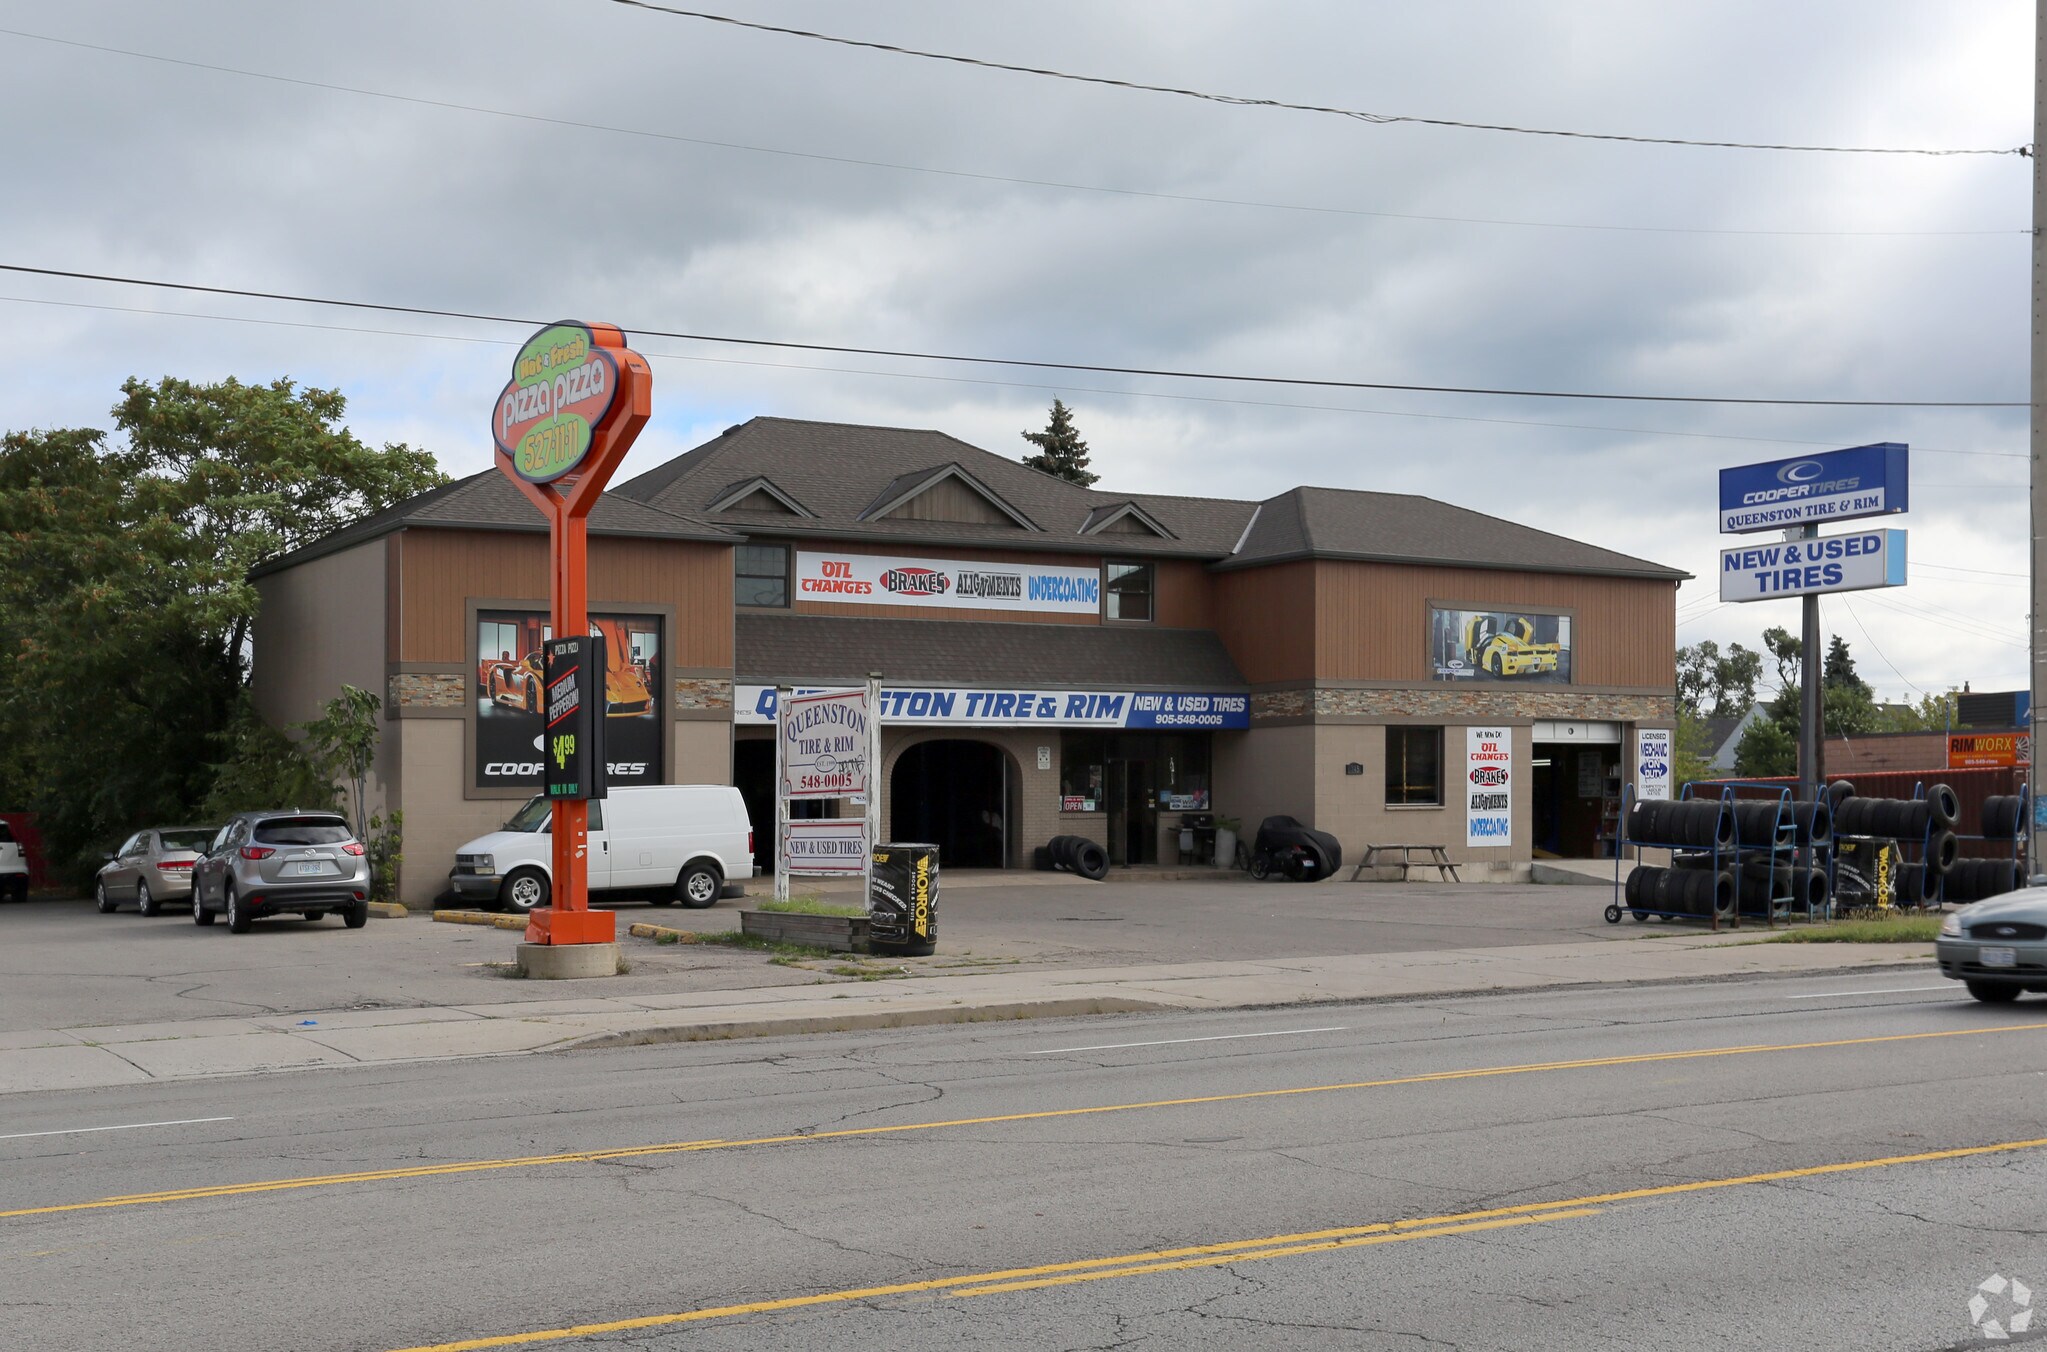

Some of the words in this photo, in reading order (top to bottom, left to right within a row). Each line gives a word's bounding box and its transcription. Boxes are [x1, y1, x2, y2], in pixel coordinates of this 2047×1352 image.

[519, 352, 542, 381] Hot
[543, 353, 549, 367] &
[550, 334, 584, 368] Fresh
[1727, 507, 1802, 529] QUEENSTON
[1805, 502, 1836, 517] TIRE
[1839, 499, 1850, 511] &
[1853, 495, 1879, 509] RIM
[1724, 547, 1780, 572] NEW
[1783, 545, 1802, 565] &
[1807, 535, 1881, 561] USED
[821, 560, 853, 579] OIL
[1755, 563, 1843, 593] TIRES
[801, 578, 873, 595] CHANGES
[887, 568, 946, 595] BRAKES
[955, 572, 1022, 598] ALIGNMENTS
[1028, 575, 1098, 604] UNDERCOATING
[965, 692, 1036, 718] TIRE
[1036, 697, 1057, 719] &
[1064, 694, 1125, 719] RIM
[1134, 696, 1163, 712] NEW
[1165, 696, 1174, 711] &
[1177, 696, 1210, 712] USED
[1213, 697, 1246, 713] TIRES
[787, 703, 866, 743] QUEENSTON
[1155, 714, 1223, 725] 905-548-0005
[799, 739, 821, 755] TIRE
[824, 737, 831, 753] &
[834, 736, 853, 752] RIM
[1481, 743, 1498, 752] OIL
[1951, 737, 2012, 752] RIMWORX
[1470, 753, 1509, 761] CHANGES
[1647, 759, 1660, 768] ON
[801, 773, 852, 789] 548-0005
[1474, 769, 1506, 785] BRAKES
[1645, 769, 1662, 779] DUTY
[1065, 802, 1083, 811] OPEN
[1470, 794, 1508, 811] ALIGNMENTS
[1470, 817, 1508, 837] UNDERCOATING
[789, 841, 807, 854] NEW
[808, 841, 815, 854] &
[816, 840, 837, 854] USED
[838, 840, 863, 854] TIRES
[915, 868, 928, 927] MONROE
